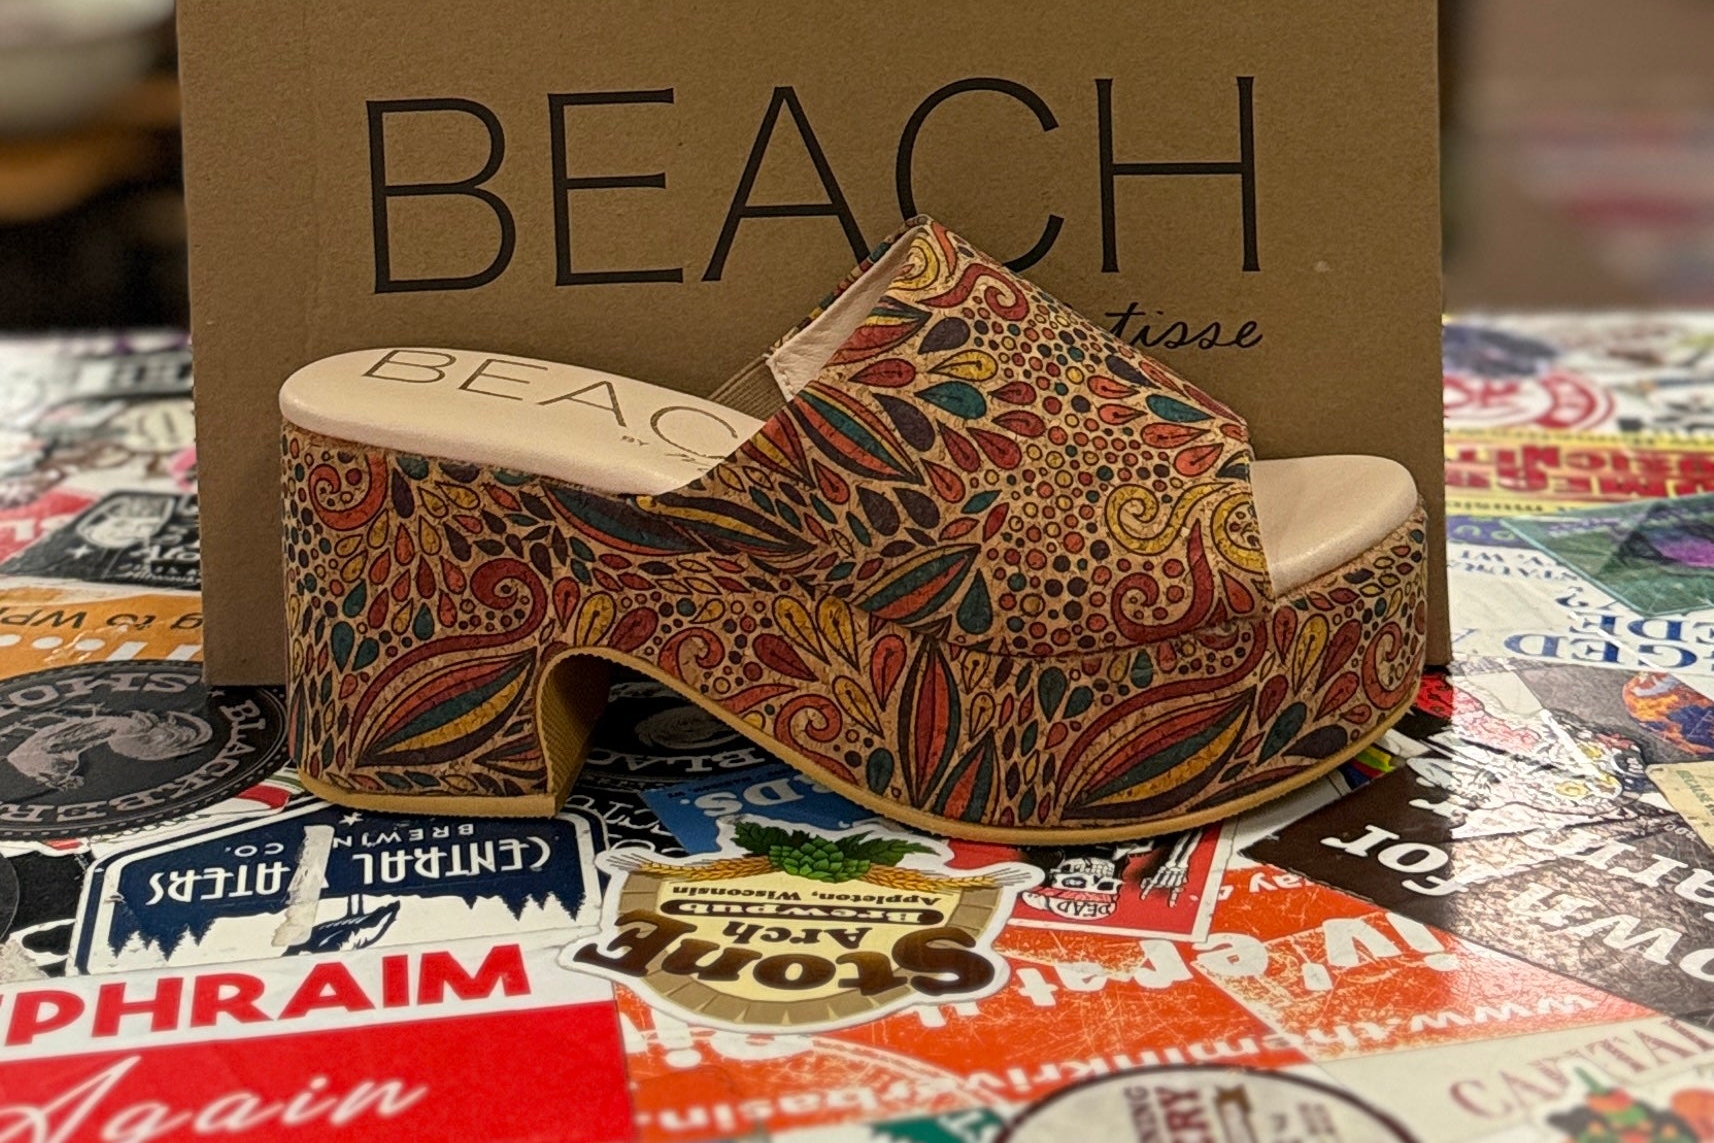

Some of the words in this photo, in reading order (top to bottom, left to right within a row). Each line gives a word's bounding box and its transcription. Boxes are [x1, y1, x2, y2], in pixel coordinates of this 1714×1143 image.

[366, 76, 1261, 295] BEACH
[1104, 302, 1263, 349] tisse
[361, 349, 738, 461] BEAC
[0, 670, 199, 716] SMO
[0, 697, 267, 824] BLACKBER
[331, 823, 476, 850] BREWIN
[146, 861, 330, 906] ATERS
[351, 836, 552, 886] CENTRAL
[671, 885, 802, 903] Wisconsin
[678, 901, 923, 925] Brewpub
[810, 888, 943, 906] Appleton,
[1057, 900, 1111, 918] DEAD
[722, 920, 874, 949] Arch
[0, 943, 531, 1048] PHRAIM
